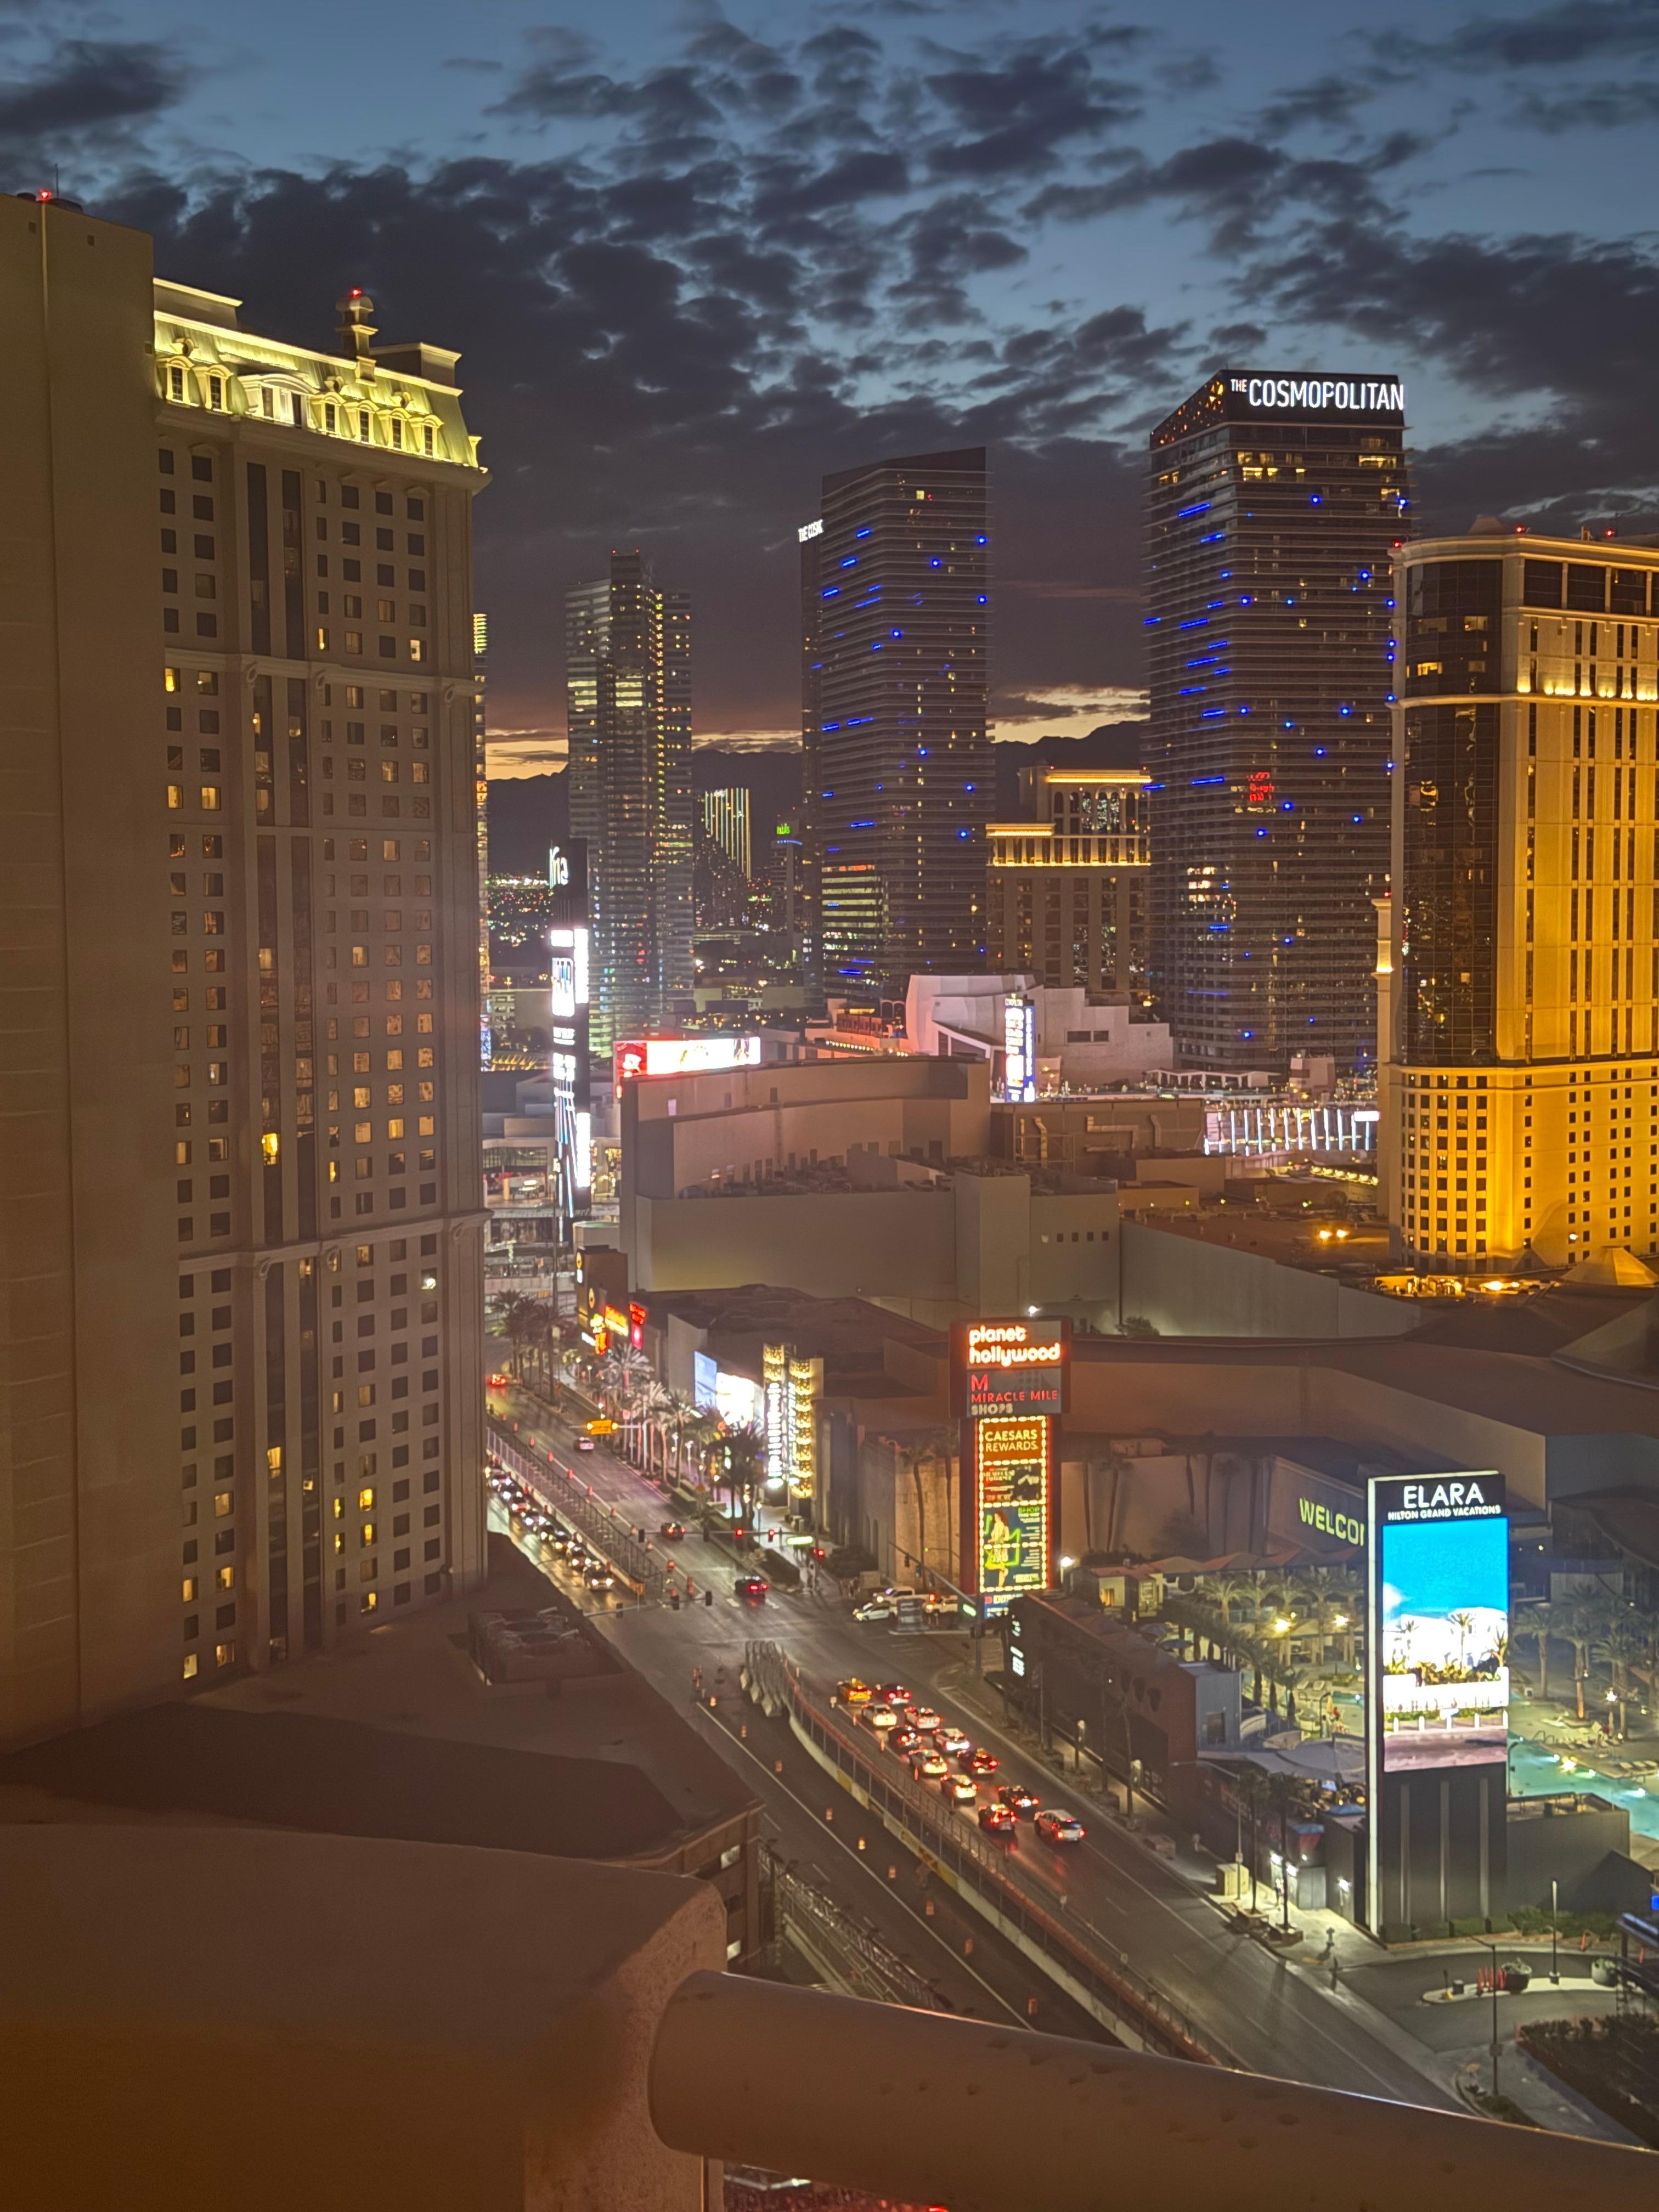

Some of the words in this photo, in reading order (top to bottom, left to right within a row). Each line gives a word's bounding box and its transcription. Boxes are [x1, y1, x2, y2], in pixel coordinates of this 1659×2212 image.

[1231, 379, 1247, 392] THE
[1249, 379, 1403, 410] COSMOPOLITAN
[969, 1325, 1026, 1346] planet
[969, 1342, 1061, 1367] hollywood
[971, 1374, 988, 1392] M
[971, 1391, 1025, 1403] MIRACLE
[1030, 1390, 1058, 1401] MILE
[971, 1403, 1013, 1415] SHOPS
[985, 1429, 1037, 1442] CAESARS
[985, 1441, 1038, 1452] REWARDS
[1403, 1482, 1484, 1509] ELARA
[1299, 1497, 1364, 1547] WELCO
[1387, 1511, 1419, 1521] HILTON
[1420, 1508, 1451, 1519] GRAND
[1453, 1505, 1502, 1516] VACATIONS
